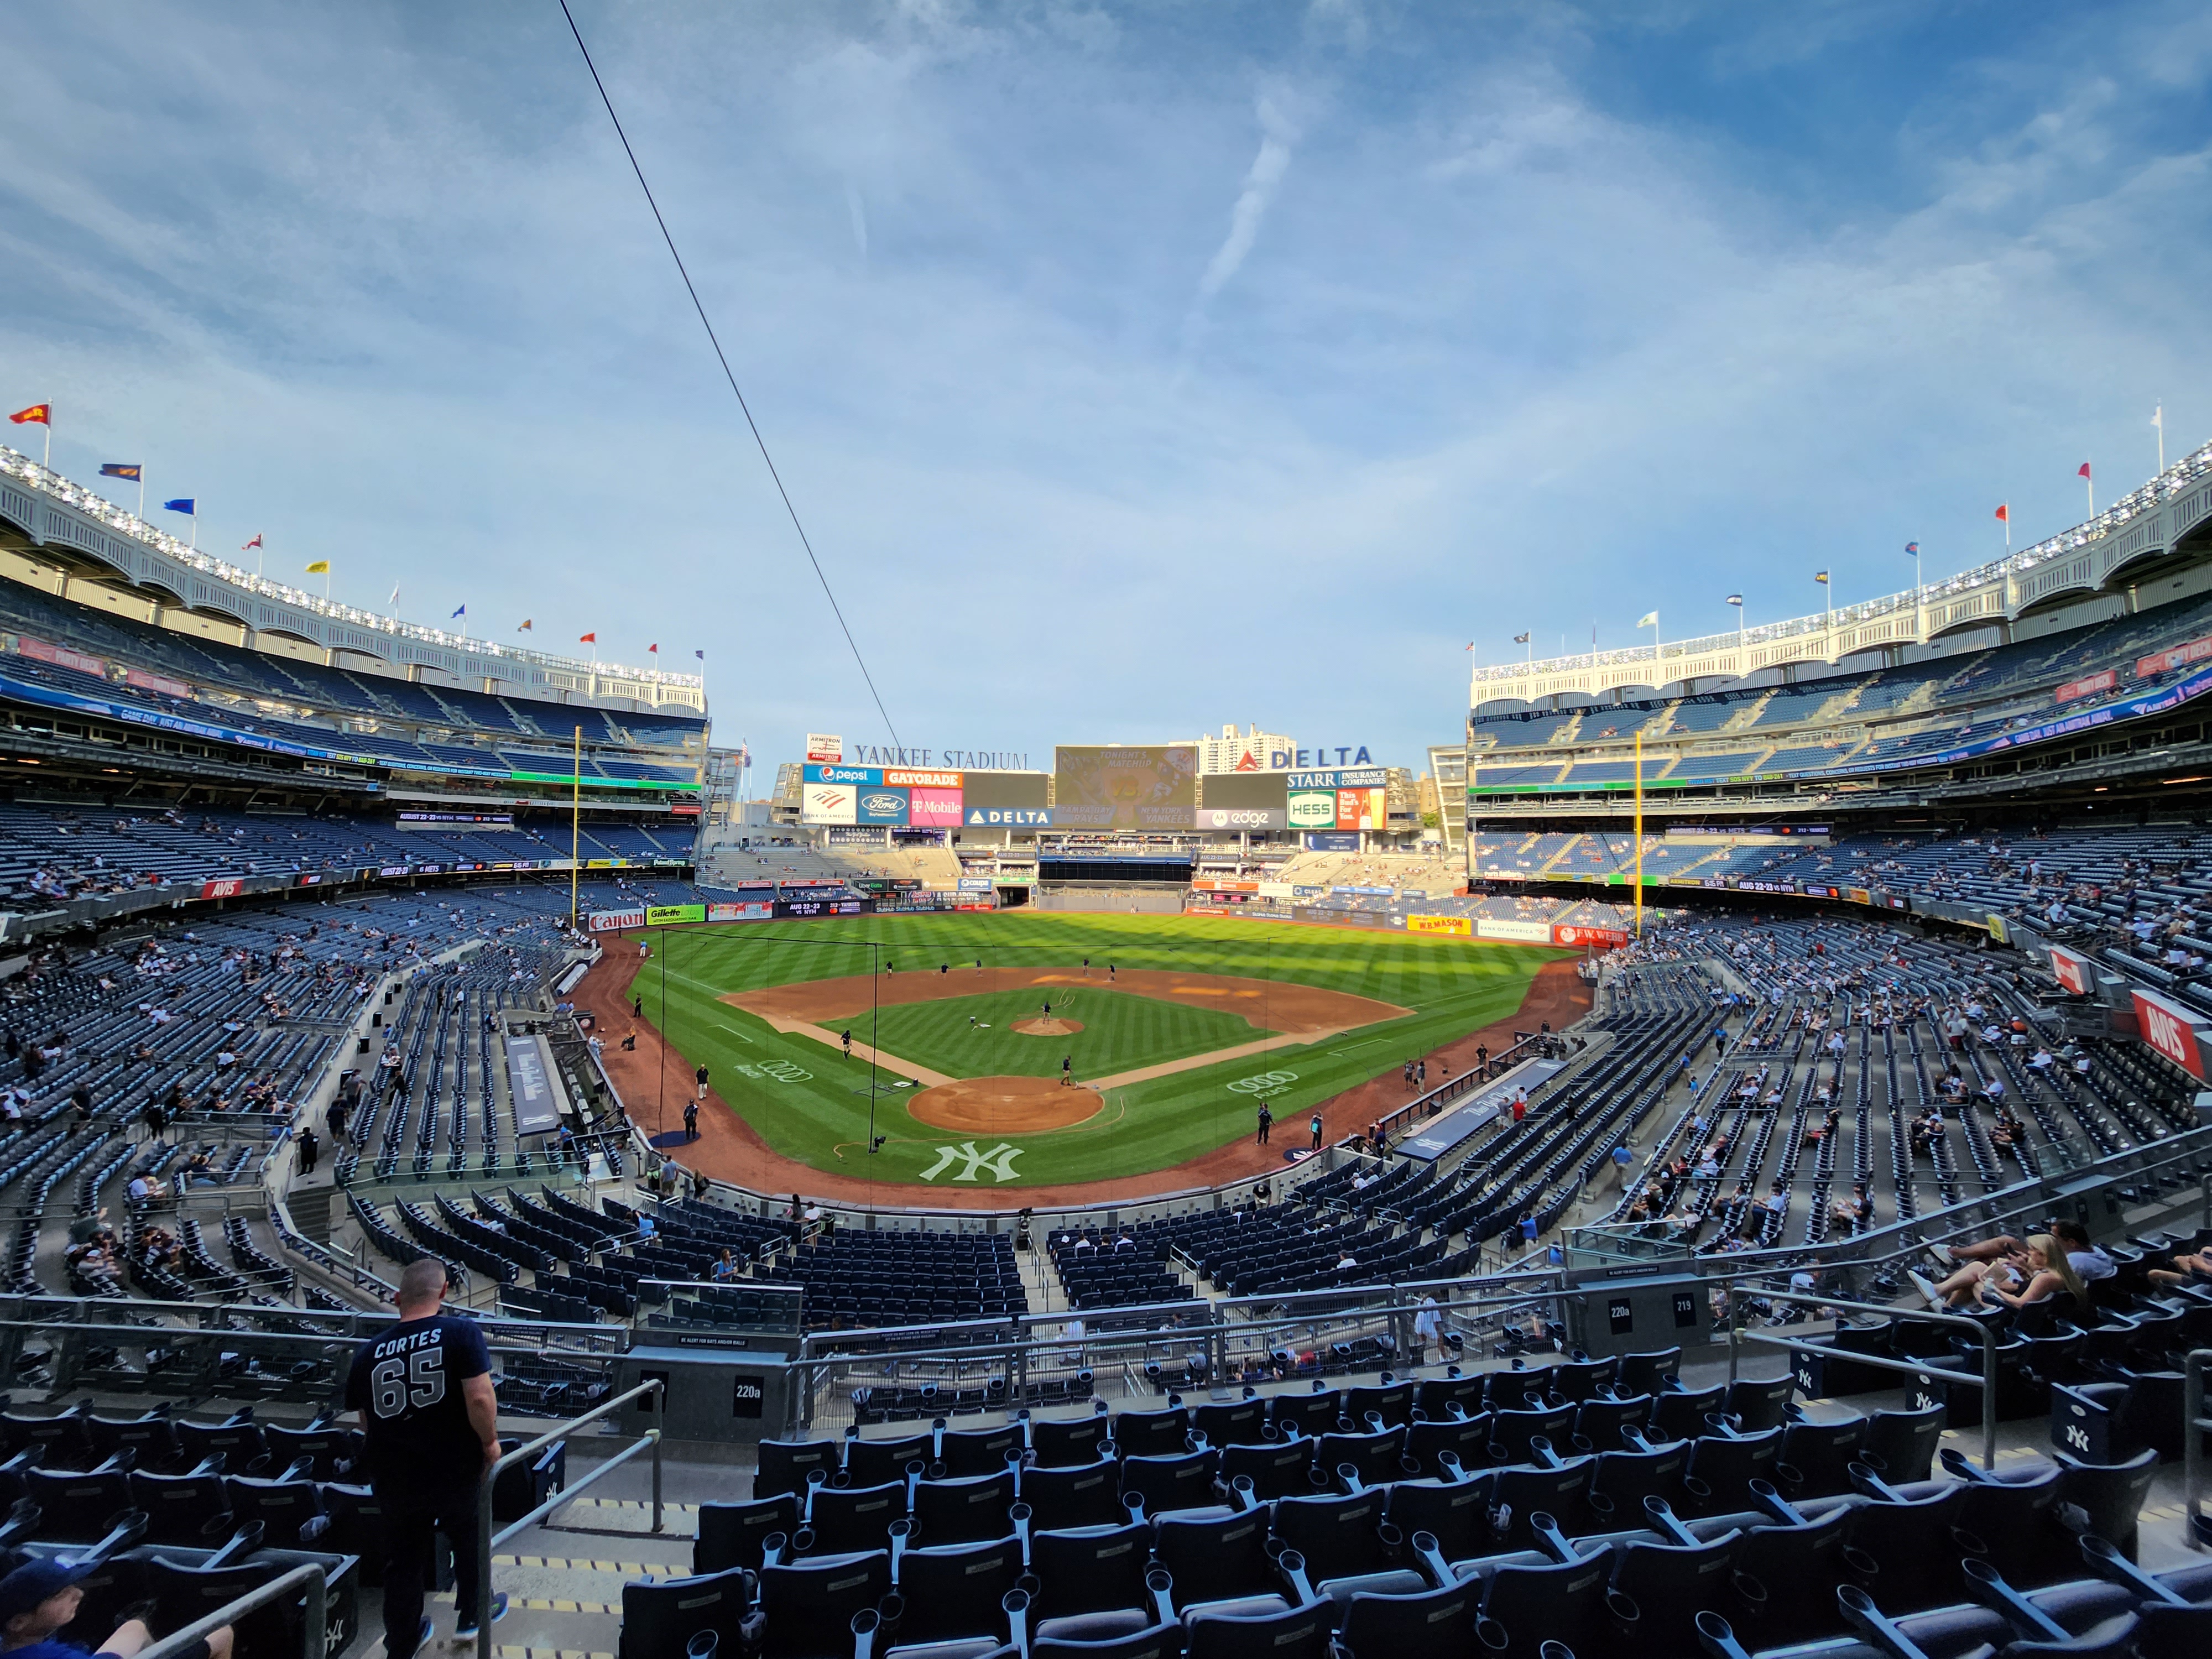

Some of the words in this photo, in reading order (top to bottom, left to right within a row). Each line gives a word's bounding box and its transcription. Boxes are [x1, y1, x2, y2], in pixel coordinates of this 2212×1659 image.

[854, 744, 932, 767] YANKEE
[943, 750, 1029, 770] STADIUM
[1271, 746, 1373, 769] DELTA
[1108, 760, 1152, 768] MATCHUP
[836, 770, 868, 781] pepsi
[888, 772, 958, 786] GATORADE
[1287, 773, 1337, 788] STARR
[1342, 770, 1386, 780] INSURANCE
[1341, 778, 1386, 786] COMPANIES
[1339, 791, 1356, 800] This
[869, 797, 899, 810] Ford
[924, 801, 962, 814] Mobile
[1292, 804, 1330, 815] HESS
[989, 811, 1048, 824] DELTA
[1073, 815, 1099, 823] RAYS
[1146, 815, 1191, 824] YANKEES
[1231, 810, 1269, 828] edge
[211, 882, 236, 897] AVIS
[1739, 880, 1754, 890] AUG
[1780, 884, 1794, 893] NYM
[651, 909, 681, 918] Gillette
[590, 912, 643, 930] Canon
[1597, 929, 1624, 942] WEBB
[2147, 1005, 2185, 1062] AVIS
[733, 1065, 765, 1078] Audi
[1253, 1085, 1293, 1099] Audi
[1611, 1306, 1630, 1319] 220a
[1677, 1300, 1692, 1312] 219
[374, 1328, 442, 1359] CORTES
[372, 1346, 445, 1419] 65
[737, 1384, 760, 1399] 220a
